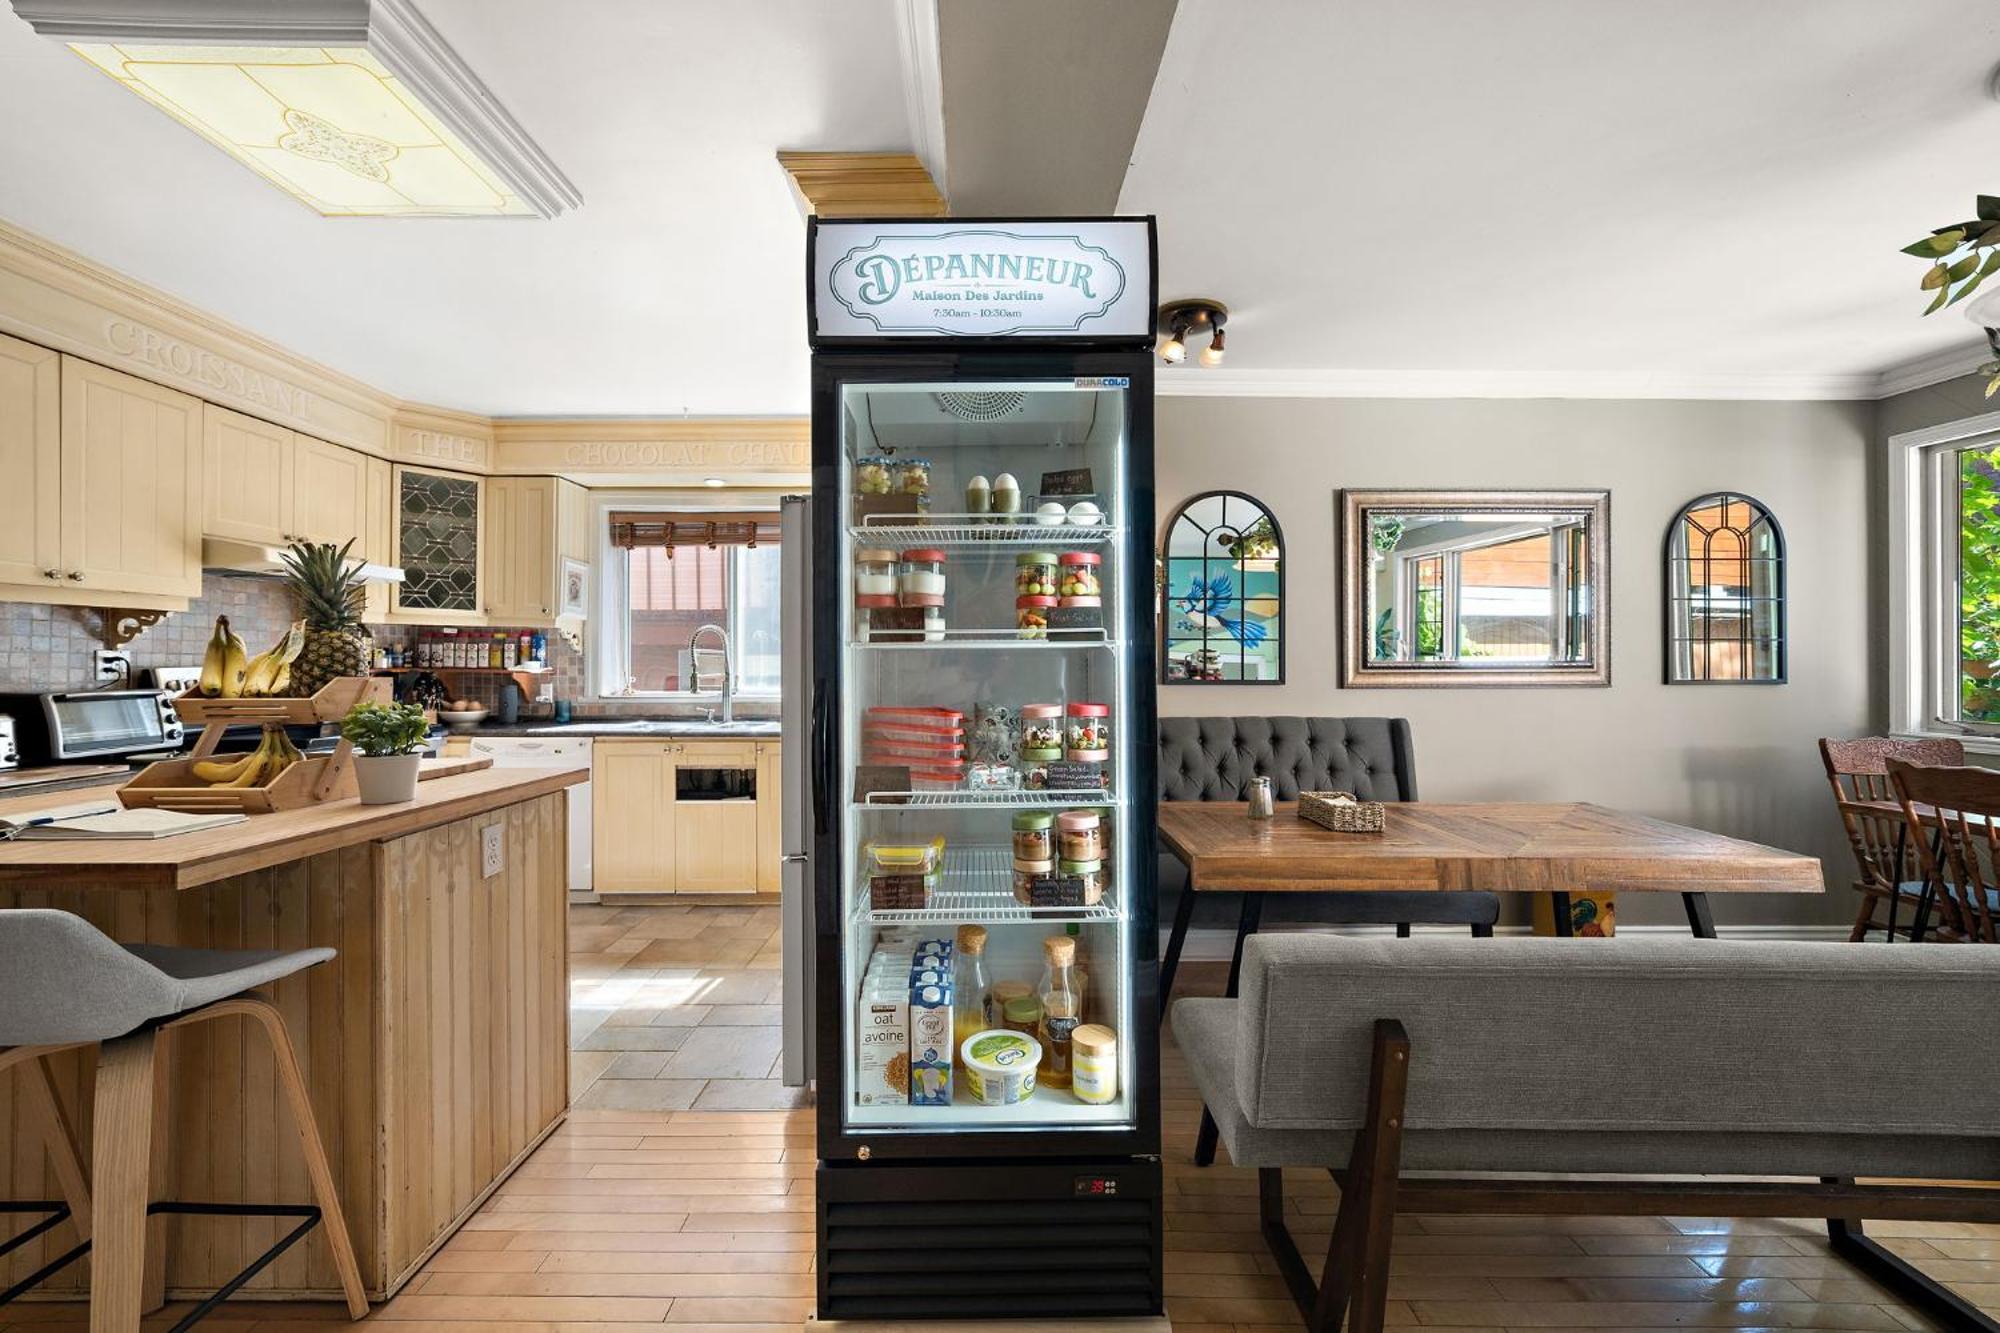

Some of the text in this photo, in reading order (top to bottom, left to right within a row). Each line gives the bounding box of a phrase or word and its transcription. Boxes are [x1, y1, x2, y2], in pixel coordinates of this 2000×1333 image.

[855, 253, 1097, 305] DÉPANNEUR
[912, 290, 1044, 302] Maison Des Jardins
[933, 308, 971, 319] 7:30am
[979, 308, 1022, 319] 10:30am
[105, 319, 313, 421] CROISSANT
[1075, 377, 1129, 388] DURACOLD
[564, 442, 811, 468] CHOCOLAT CHAU
[874, 1013, 895, 1025] oat
[864, 1029, 904, 1043] avoine
